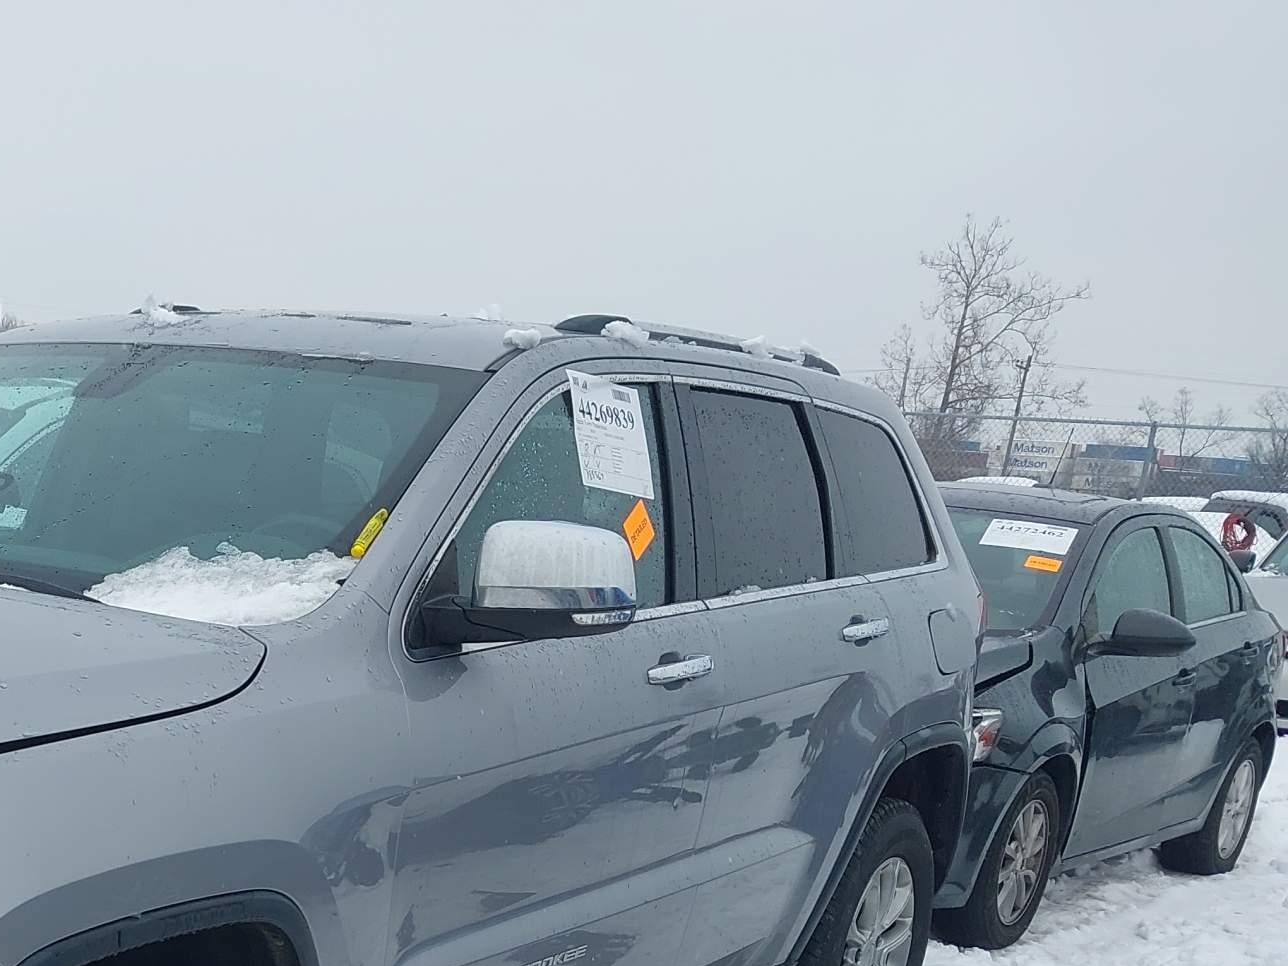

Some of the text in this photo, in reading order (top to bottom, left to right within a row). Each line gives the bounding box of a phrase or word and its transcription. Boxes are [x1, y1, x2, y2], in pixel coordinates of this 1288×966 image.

[578, 397, 635, 430] 44269839
[1013, 442, 1055, 455] Matson
[996, 525, 1065, 538] 44272462
